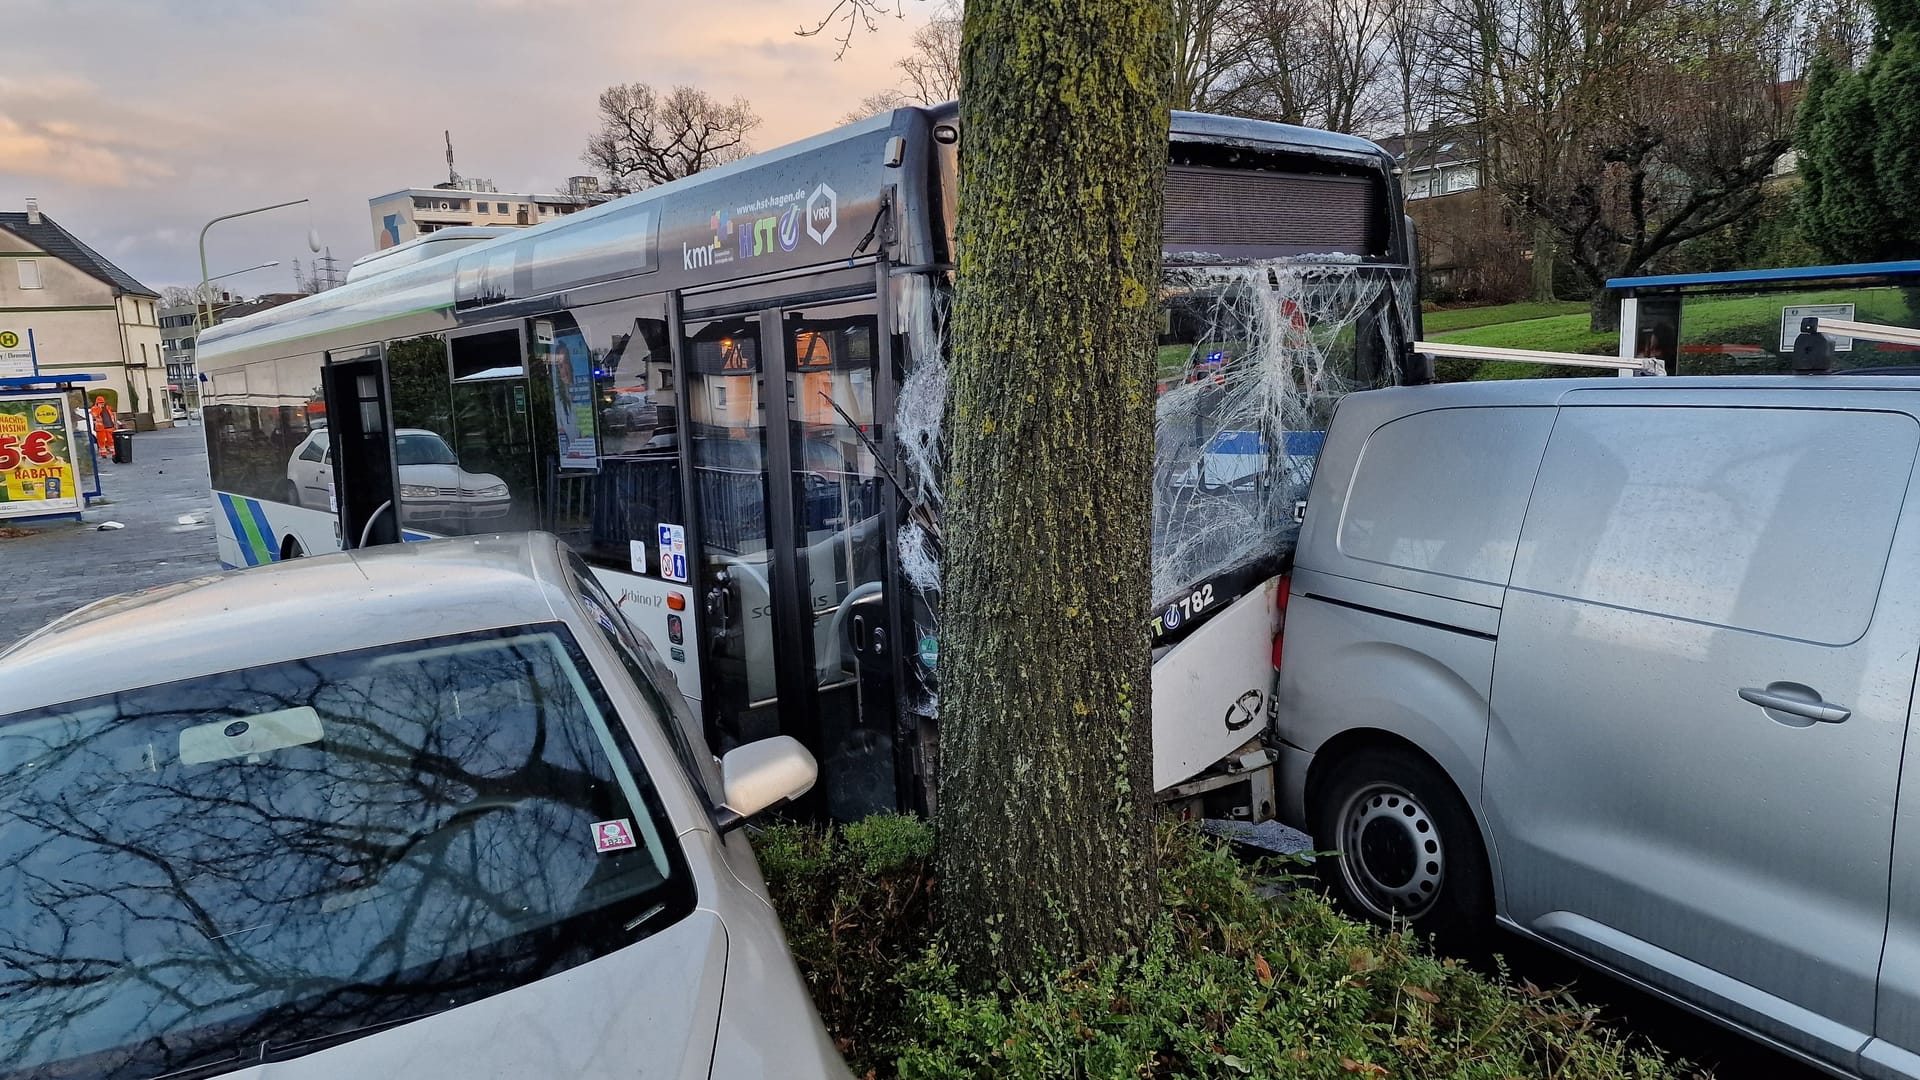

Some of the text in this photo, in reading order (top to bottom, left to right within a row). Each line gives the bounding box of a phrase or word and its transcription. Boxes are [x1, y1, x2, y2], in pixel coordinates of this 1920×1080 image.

[737, 189, 805, 214] www.hst-hagen.de
[813, 207, 829, 221] VRR
[739, 217, 776, 258] HST
[683, 242, 715, 270] kmr
[15, 467, 63, 480] RABATT
[653, 595, 662, 608] 12
[1179, 583, 1214, 620] 782
